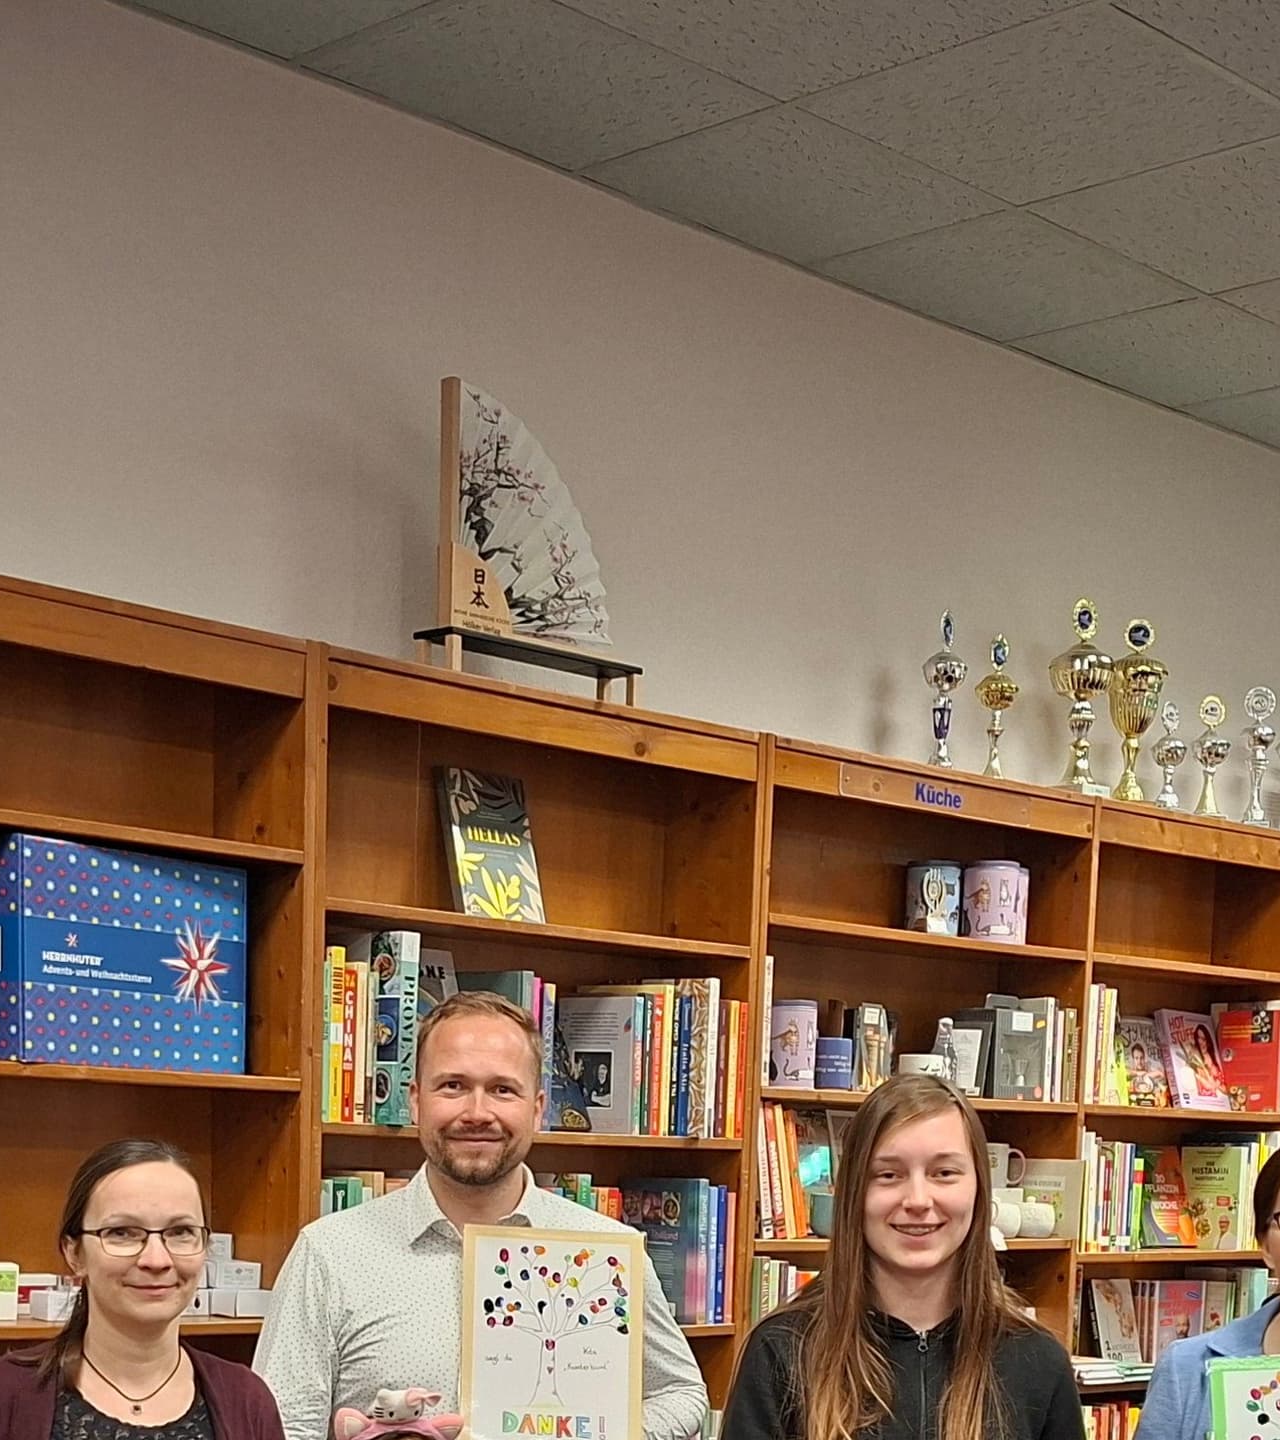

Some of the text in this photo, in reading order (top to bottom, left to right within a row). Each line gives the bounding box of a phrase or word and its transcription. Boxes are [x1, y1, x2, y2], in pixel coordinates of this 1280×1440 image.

[470, 568, 490, 609] 日本
[915, 783, 962, 809] Küche
[467, 826, 521, 847] HELLAS
[332, 966, 344, 1005] HABIBI
[343, 990, 355, 1063] CHINA
